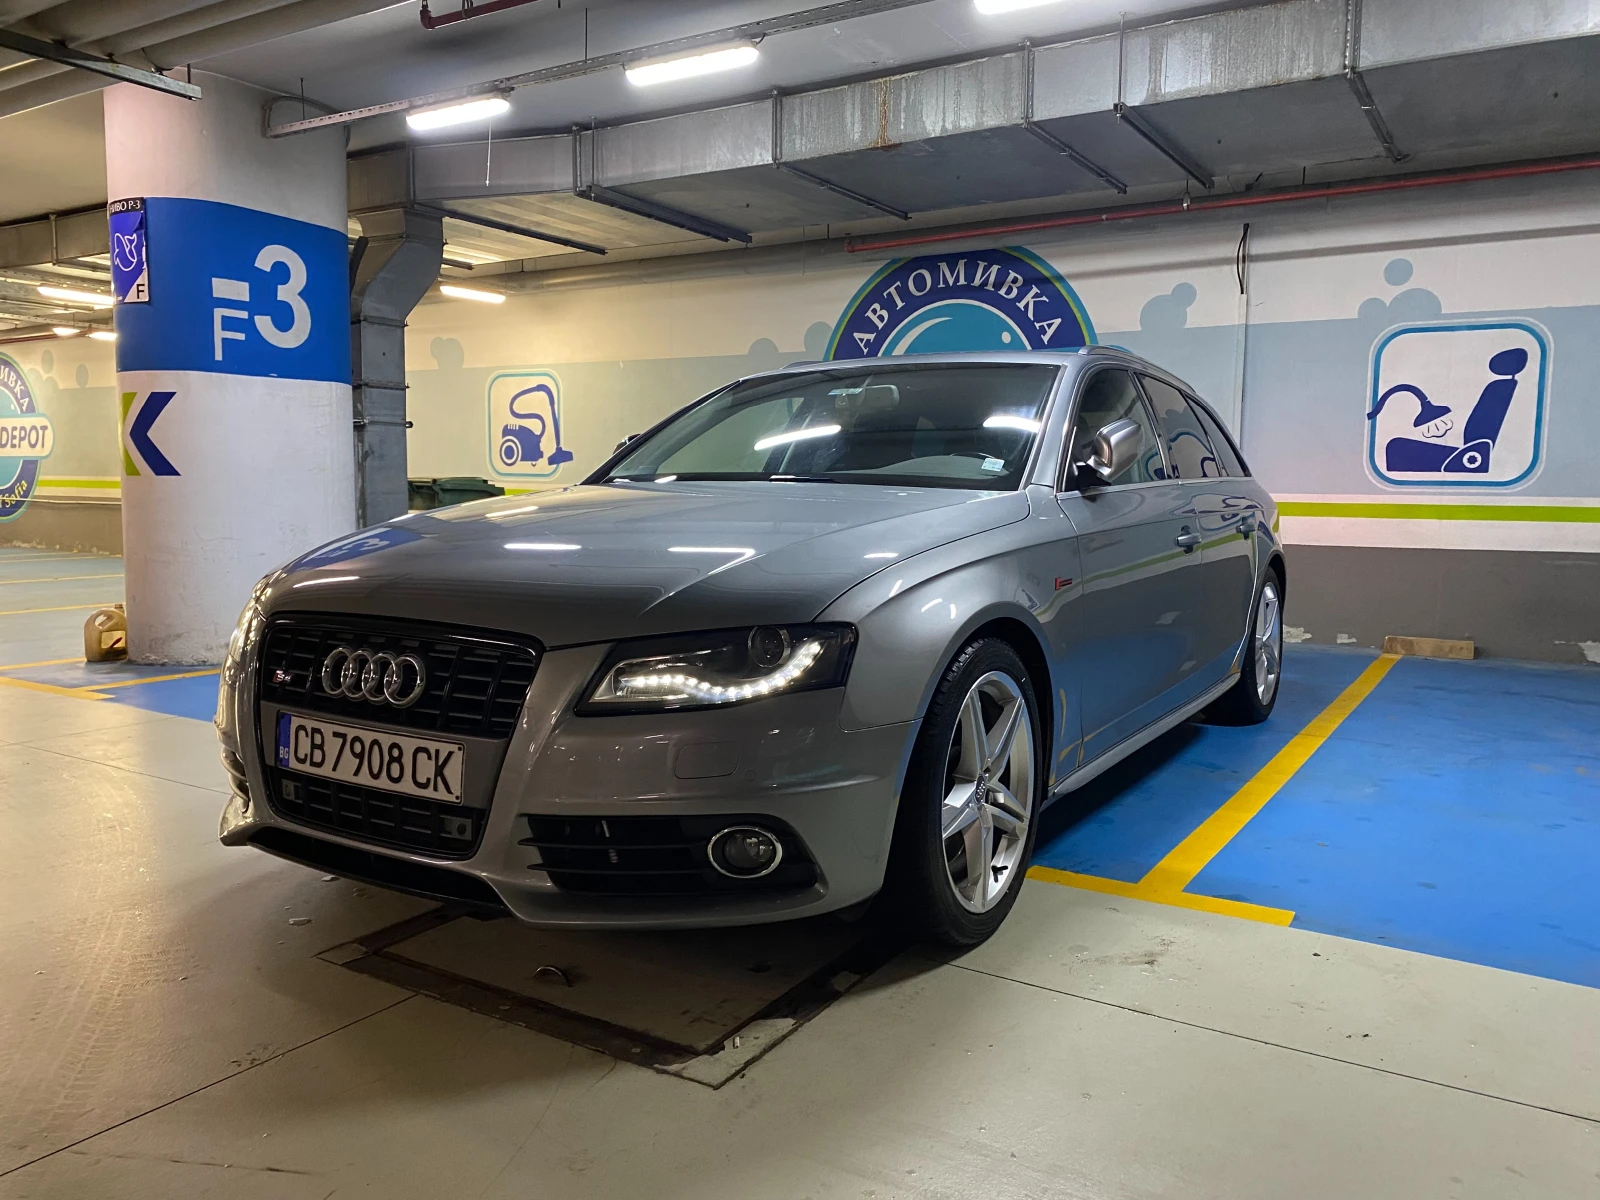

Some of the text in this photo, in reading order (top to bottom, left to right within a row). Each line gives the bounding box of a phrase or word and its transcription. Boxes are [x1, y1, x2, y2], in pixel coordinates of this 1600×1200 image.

[136, 283, 145, 299] F
[852, 258, 1063, 356] АВТОМИВКА
[0, 425, 48, 449] DEPOT
[279, 745, 289, 759] BG
